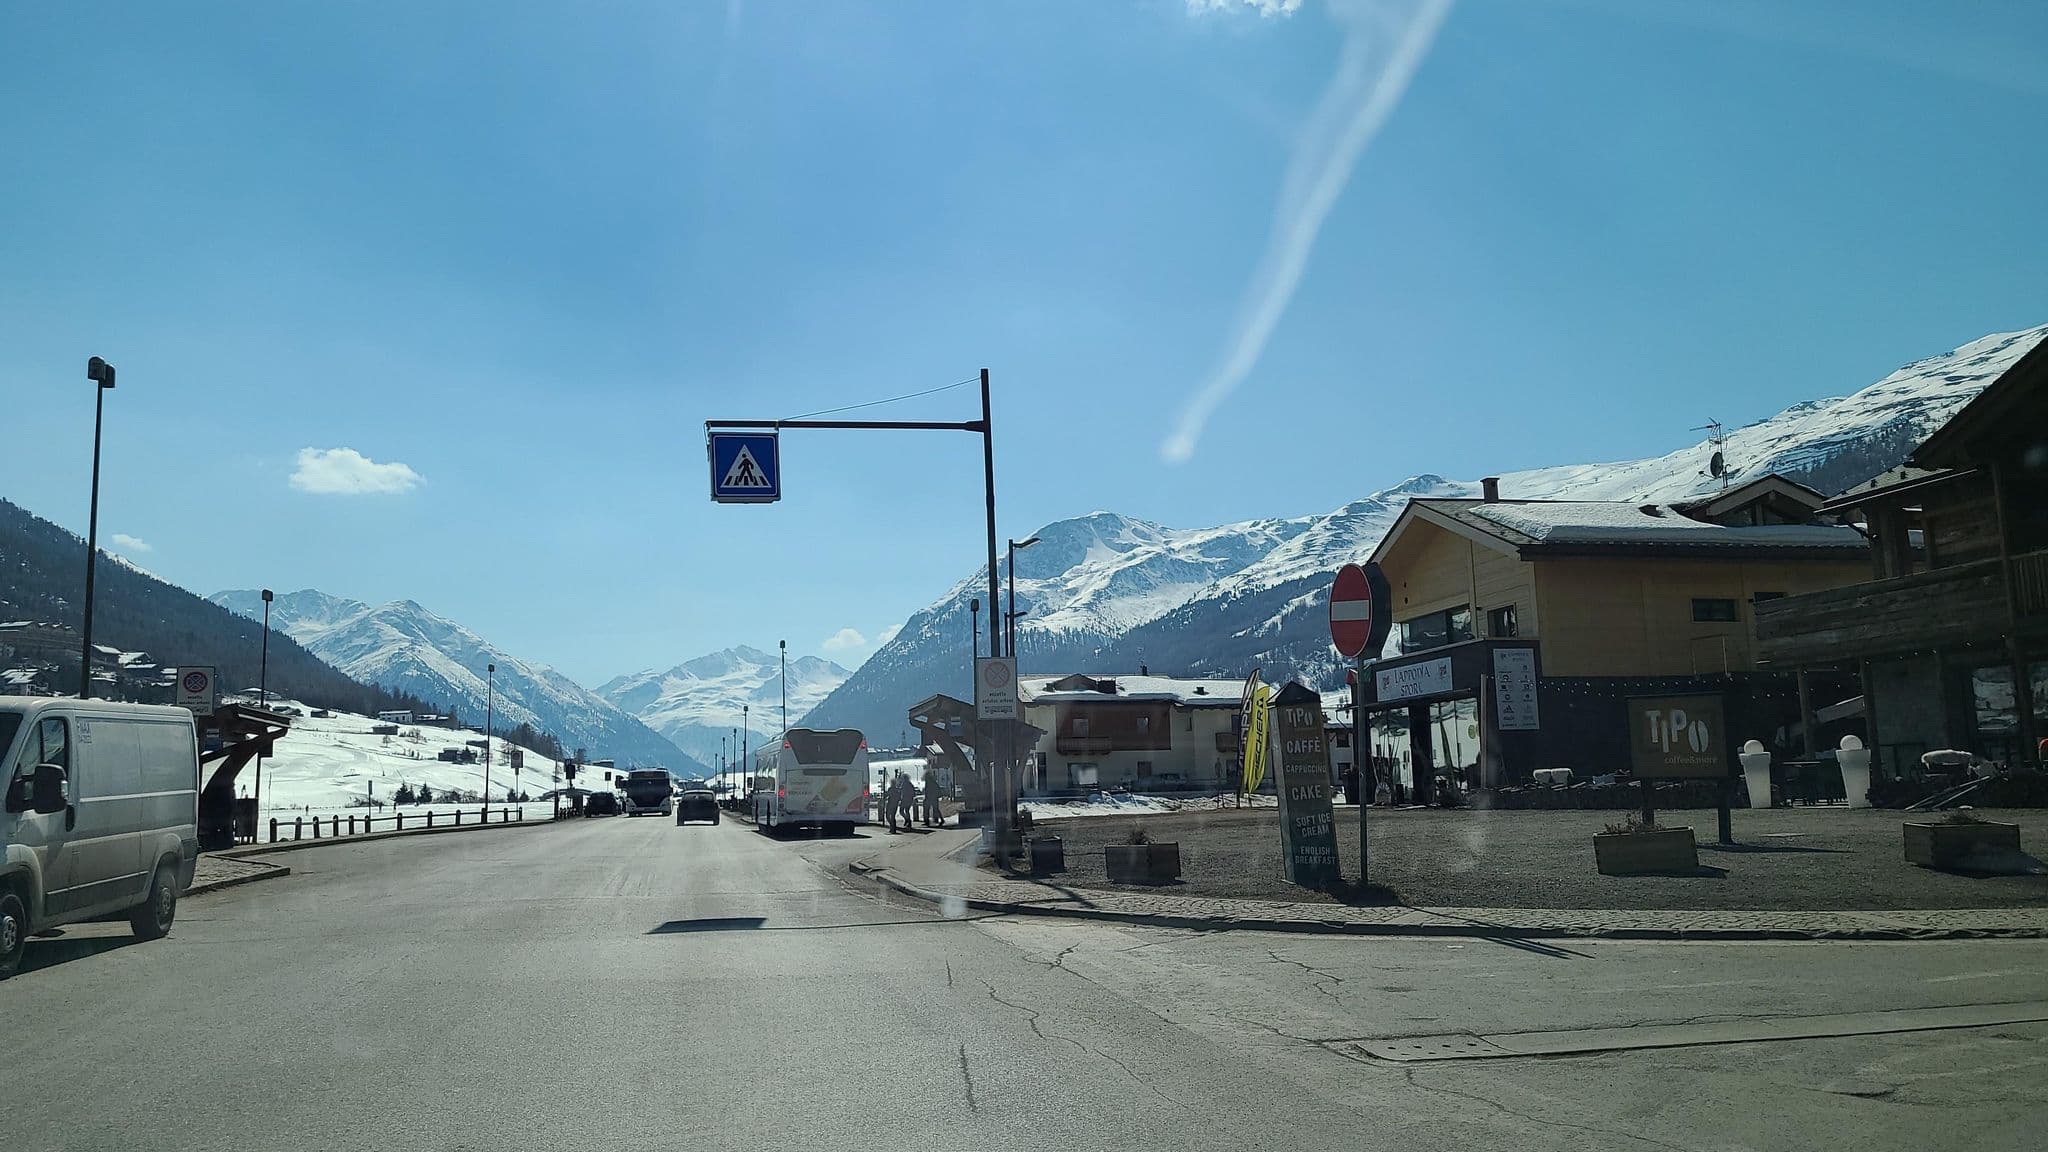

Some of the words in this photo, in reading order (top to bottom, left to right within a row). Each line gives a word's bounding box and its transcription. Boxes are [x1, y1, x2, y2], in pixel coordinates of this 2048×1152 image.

[1291, 784, 1323, 801] CAKE
[1295, 815, 1316, 828] SOFT
[1317, 812, 1332, 824] ICE
[1301, 824, 1330, 838] CREAM
[1300, 845, 1331, 856] ENGLISH
[1294, 855, 1336, 865] BREAKFAST
